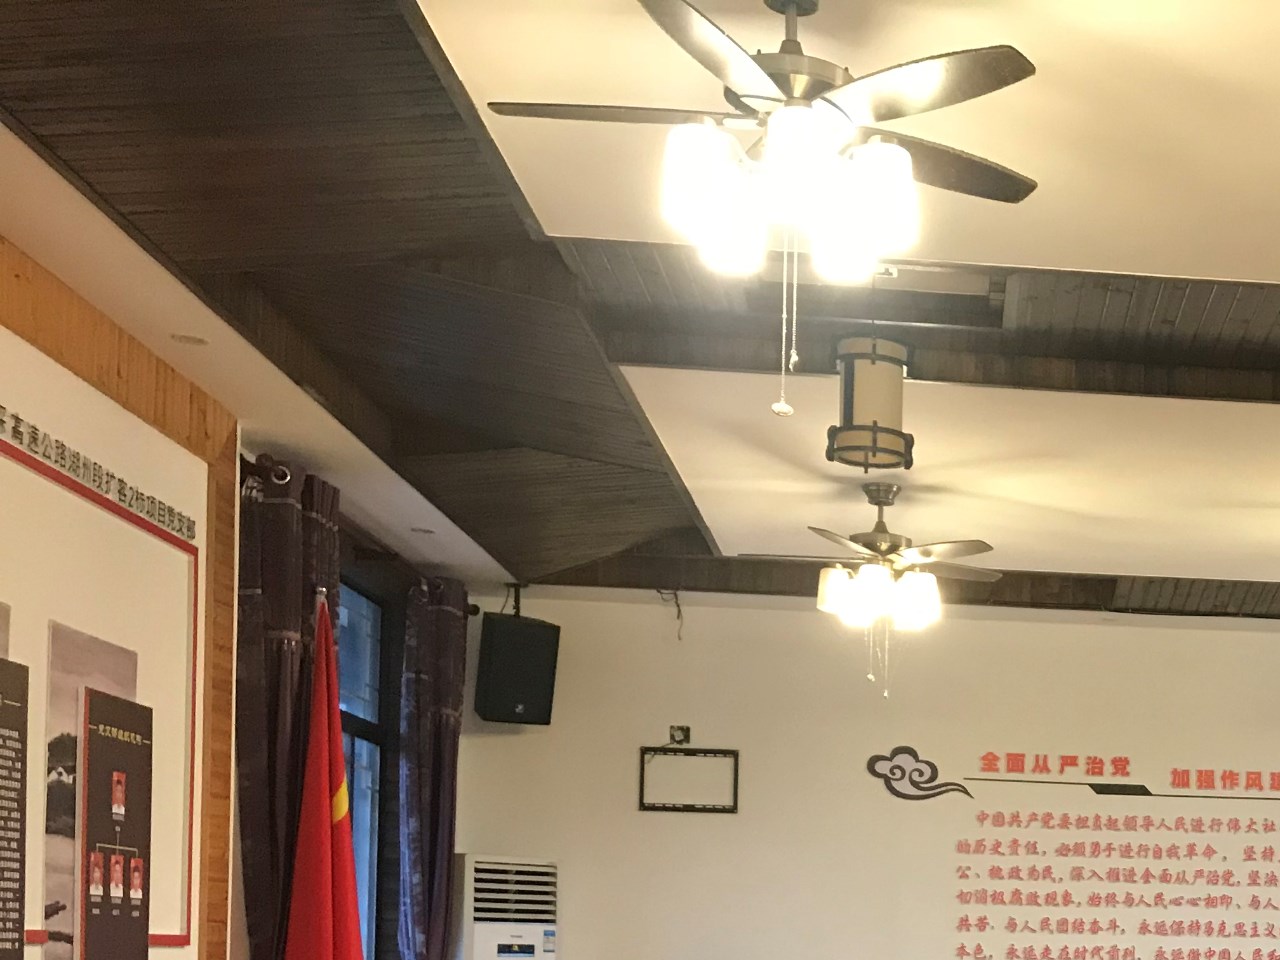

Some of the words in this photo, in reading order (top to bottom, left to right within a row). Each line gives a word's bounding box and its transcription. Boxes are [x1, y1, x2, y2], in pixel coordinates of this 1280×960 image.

[979, 751, 1131, 777] 全面从严治党
